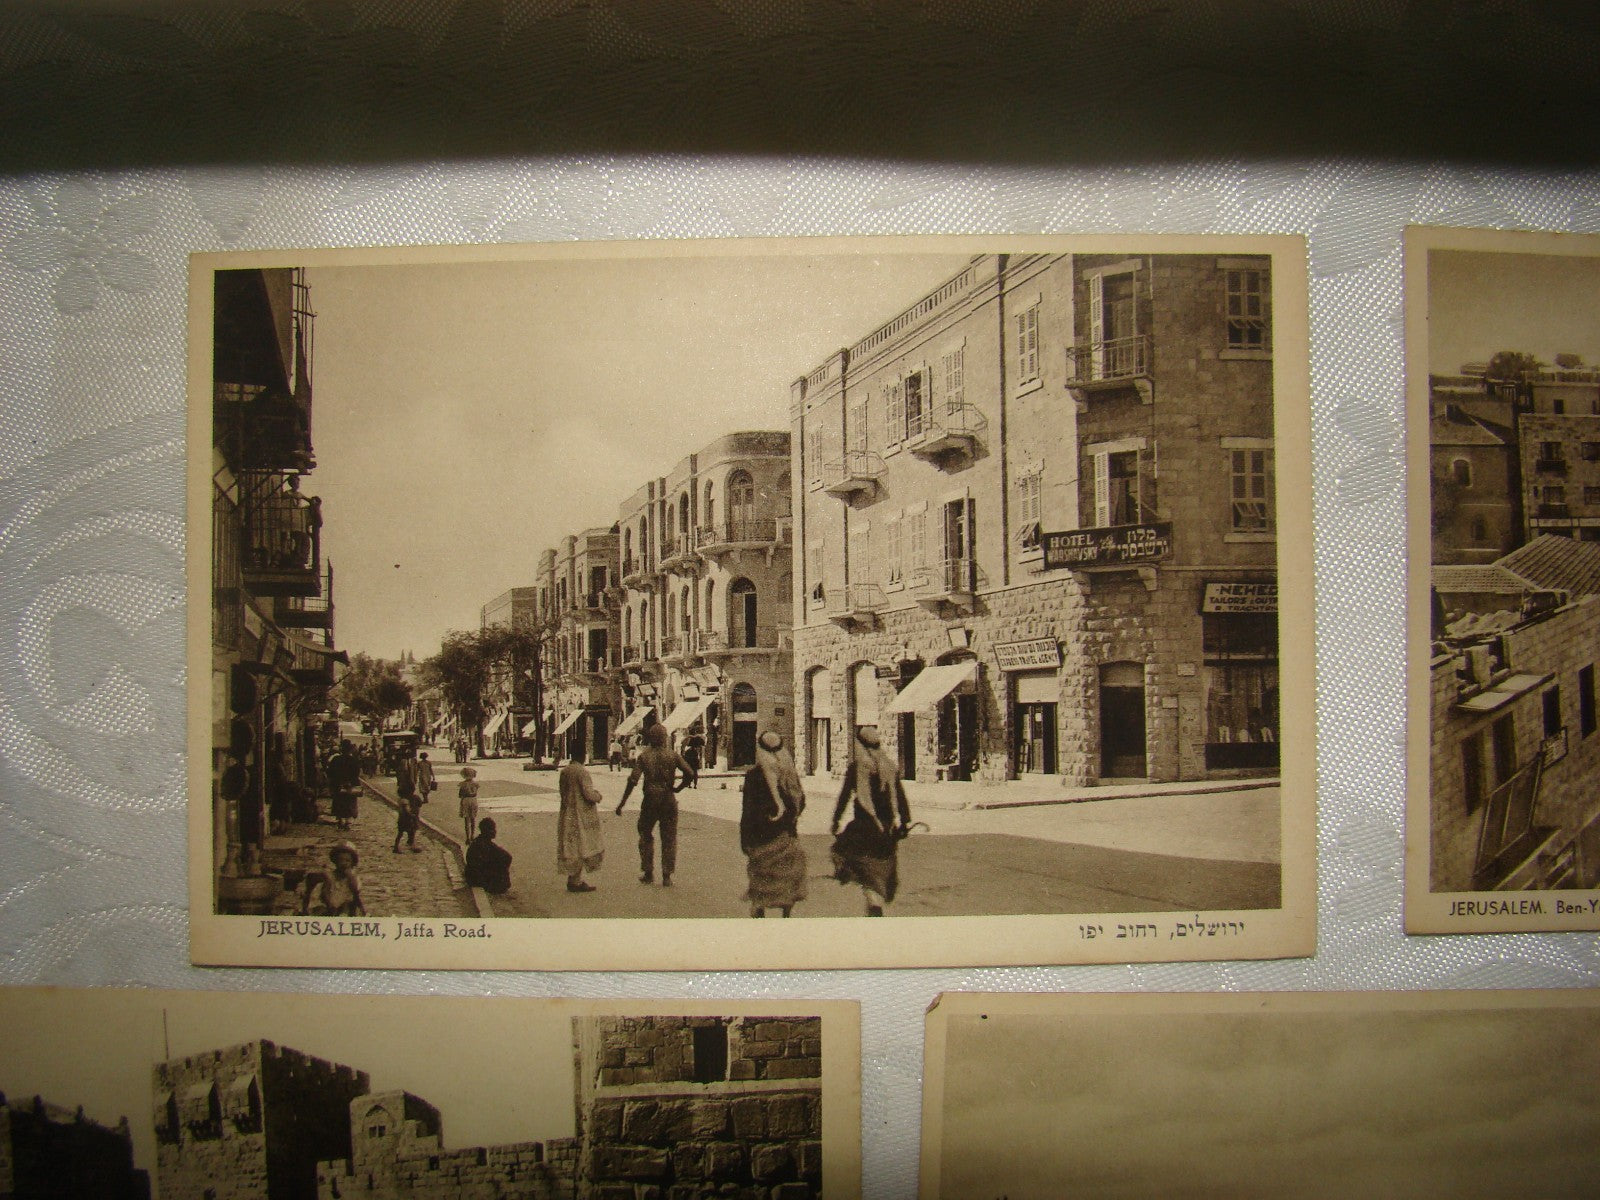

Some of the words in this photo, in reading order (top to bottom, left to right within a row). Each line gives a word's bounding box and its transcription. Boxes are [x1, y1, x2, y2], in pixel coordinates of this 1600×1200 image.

[1050, 534, 1095, 548] HOTEL
[1127, 528, 1156, 543] מלון
[1449, 900, 1547, 916] JERUSALEM.
[1556, 899, 1600, 914] Ben-Y
[256, 920, 387, 939] JERUSALEM,
[394, 922, 435, 941] Jaffa
[443, 923, 493, 939] Road.
[1079, 924, 1104, 939] יפו
[1116, 923, 1158, 939] רחוב
[1169, 914, 1245, 941] ירושלים,
